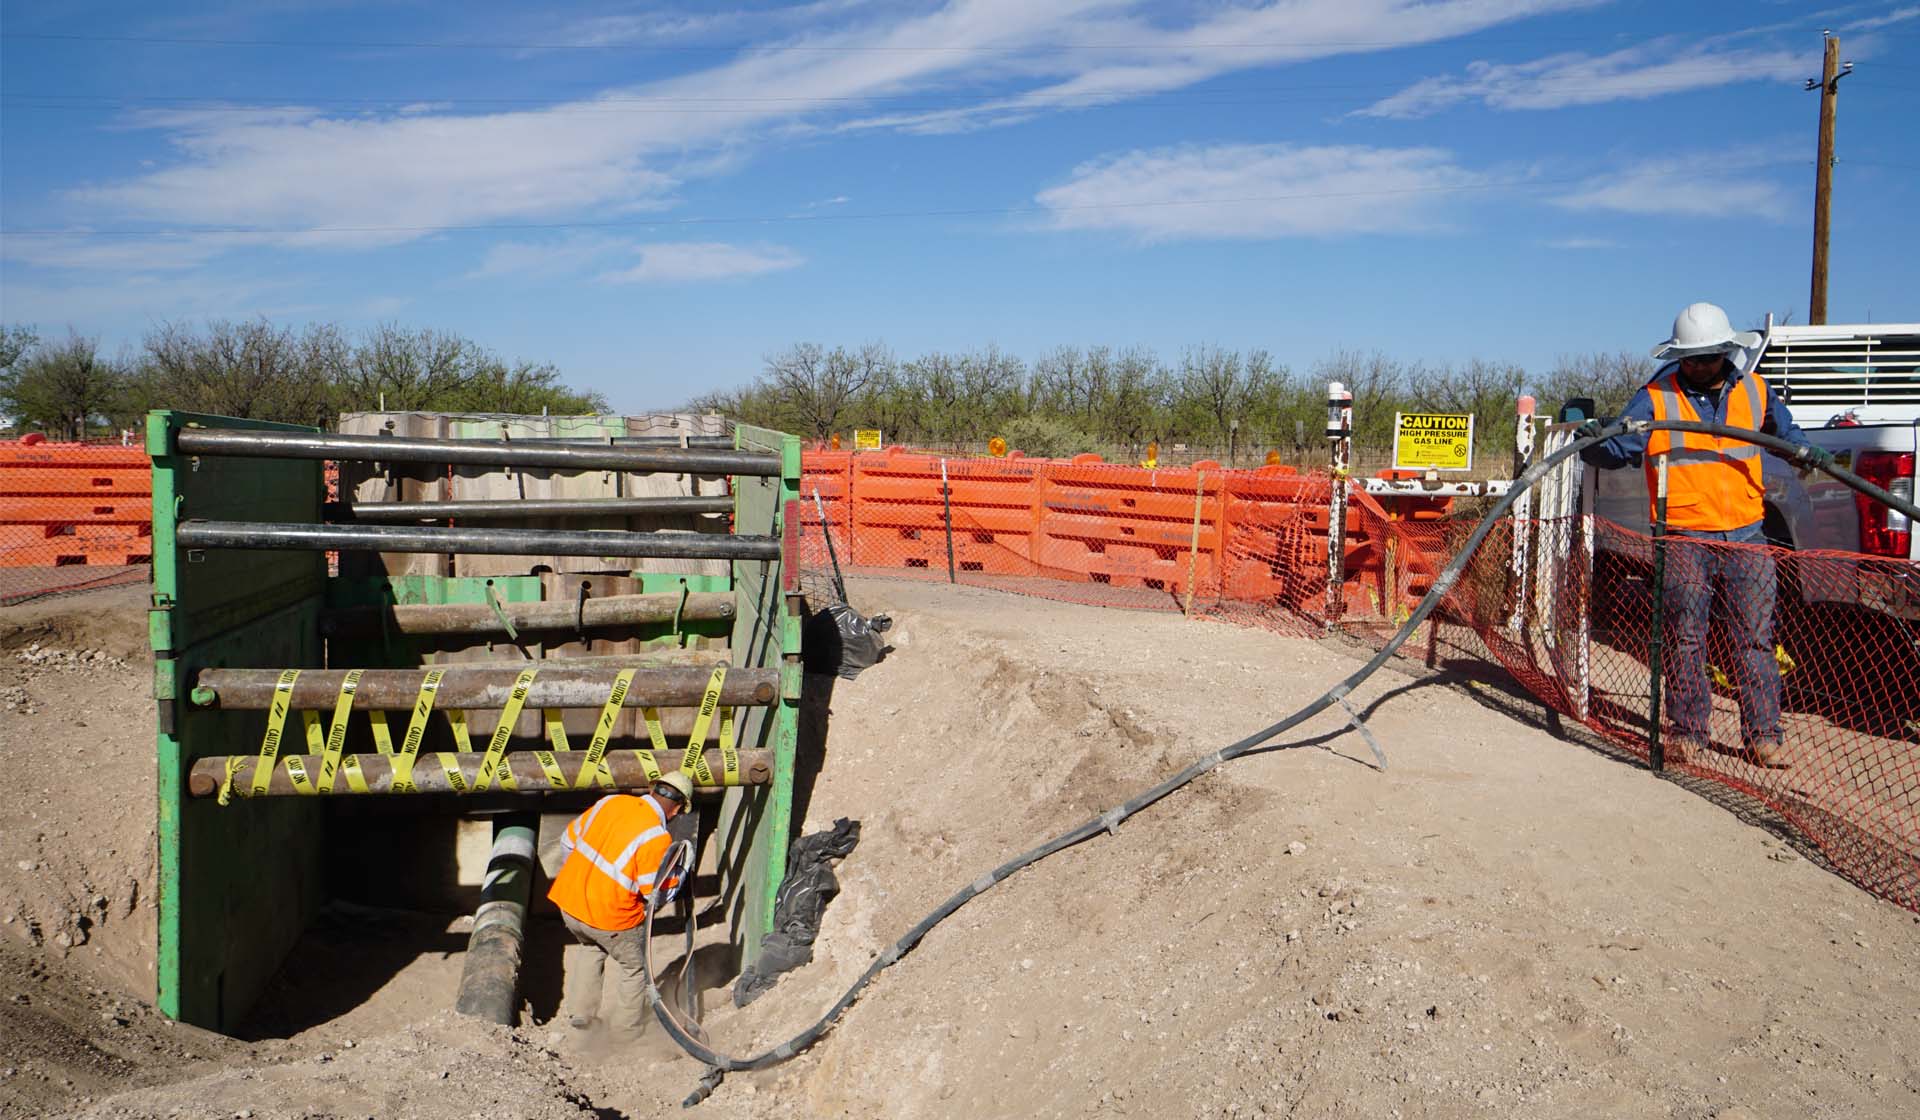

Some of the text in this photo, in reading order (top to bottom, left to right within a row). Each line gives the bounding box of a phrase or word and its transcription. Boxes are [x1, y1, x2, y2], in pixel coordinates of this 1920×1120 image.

[1402, 416, 1467, 429] CAUTION
[1425, 430, 1468, 438] PRESSURE
[279, 670, 297, 693] AUTIN
[344, 670, 361, 695] AUTIN
[424, 670, 441, 693] AUTIN
[610, 678, 628, 706] CAUTION
[701, 690, 718, 716] CAUTION
[264, 728, 280, 758] CAUTION
[329, 723, 345, 752] CAUTION
[405, 726, 422, 755] CAUTION
[491, 726, 509, 754] CAUTION
[587, 736, 606, 764] CAUTION
[684, 742, 701, 769] CAUTION
[696, 756, 711, 782] AUTION
[288, 758, 306, 785] CAUTON
